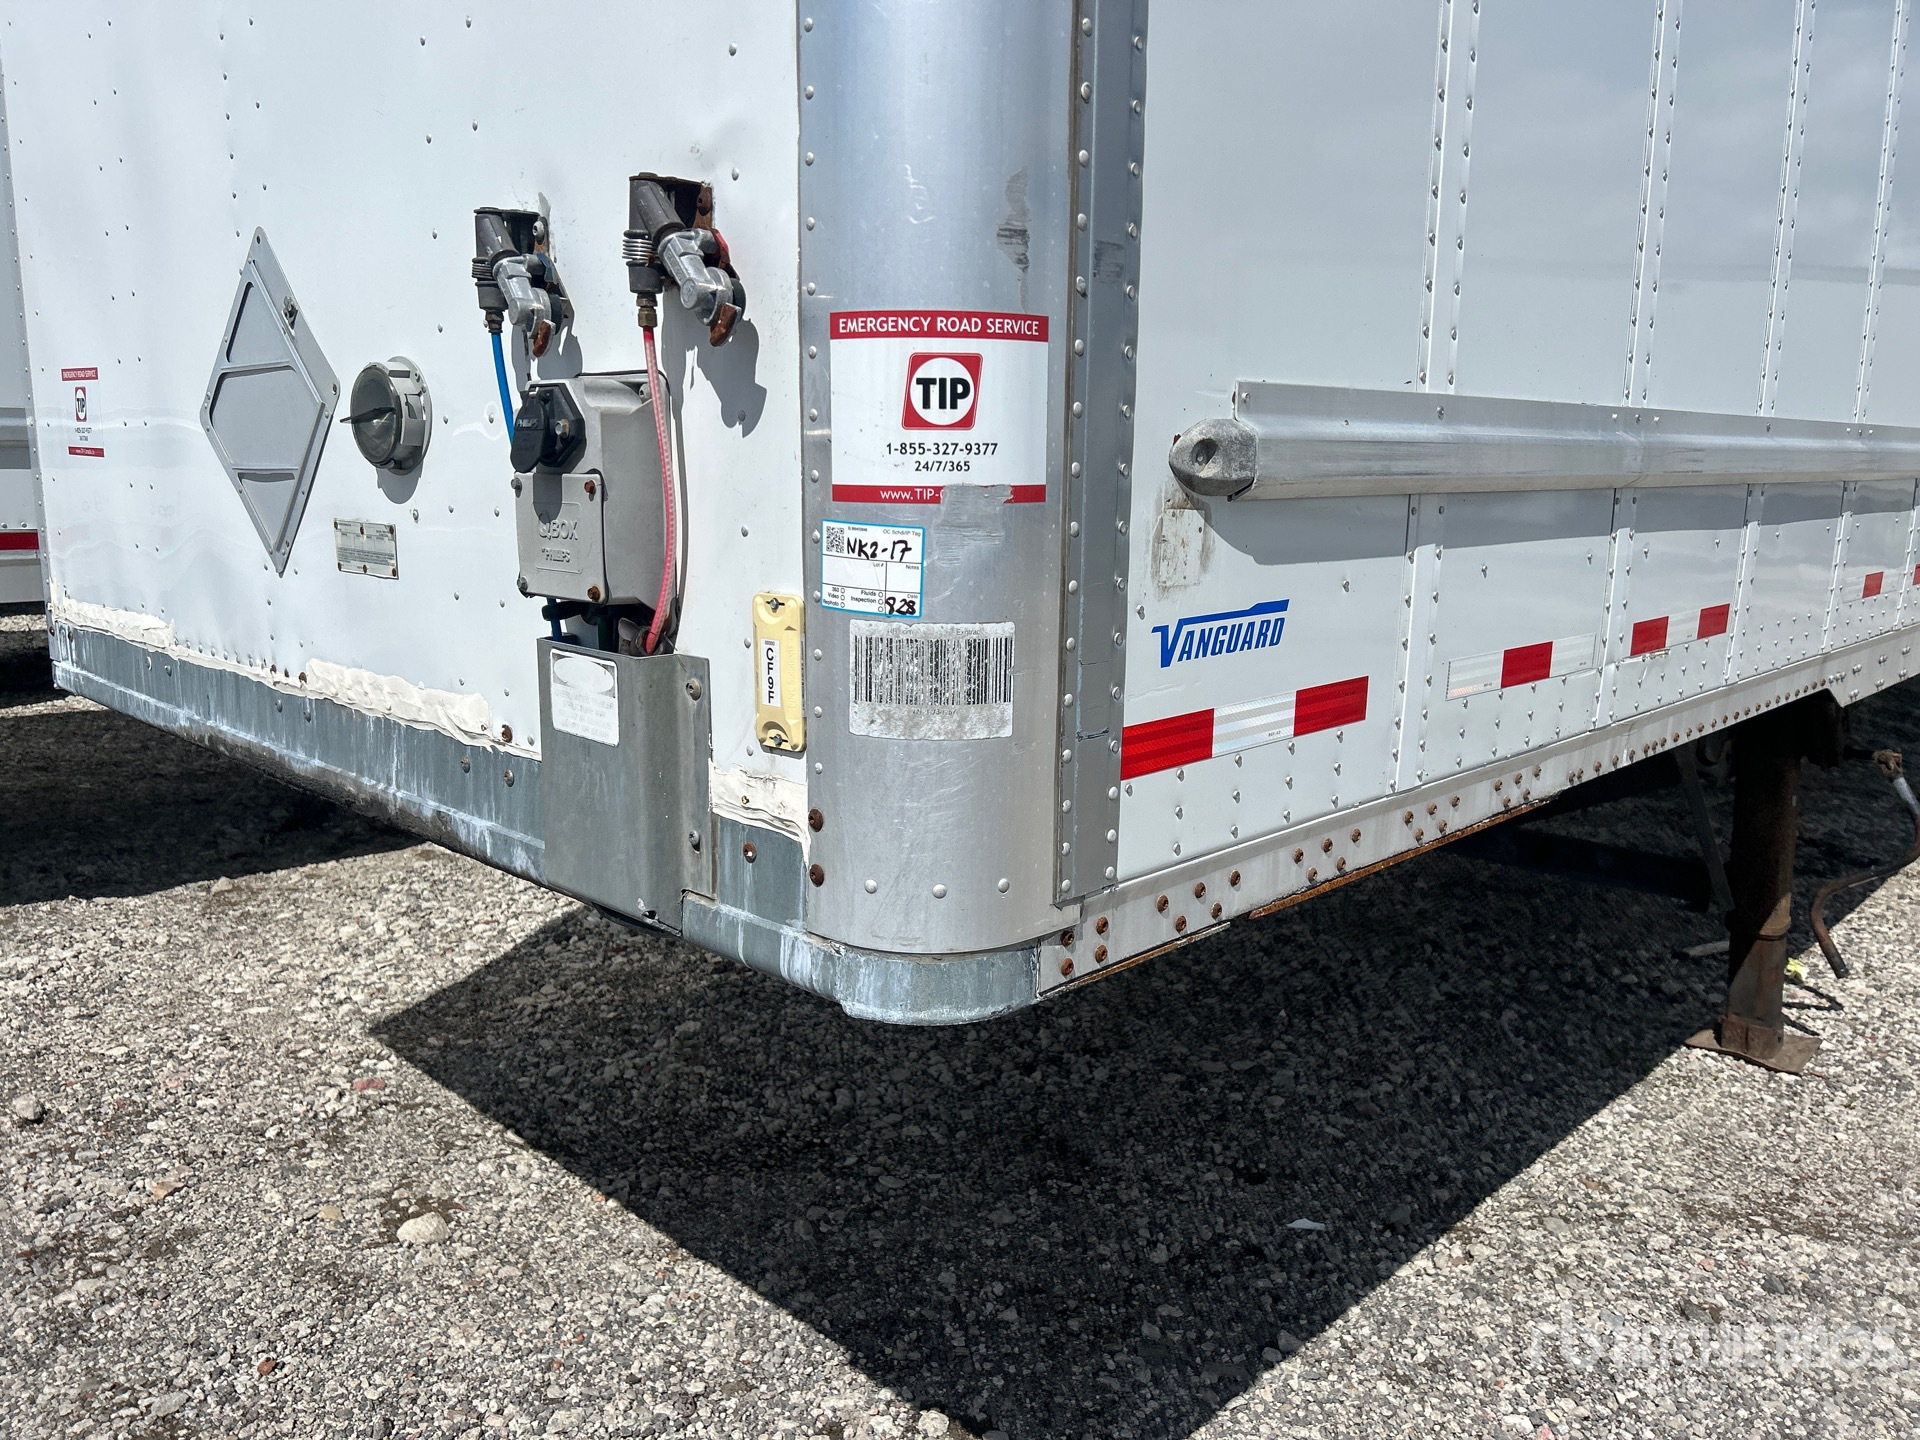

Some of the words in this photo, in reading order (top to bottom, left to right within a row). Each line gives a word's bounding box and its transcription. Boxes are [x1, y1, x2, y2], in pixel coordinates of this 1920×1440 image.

[839, 317, 931, 333] EMERGENCY
[936, 317, 982, 332] ROAD
[986, 318, 1040, 336] SERVICE
[916, 377, 971, 410] TIP
[76, 397, 87, 413] TIP
[886, 442, 998, 456] 1-855-327-9377
[914, 460, 971, 472] 24/7/365
[851, 596, 876, 604] Inspection
[1151, 599, 1290, 669] VANGUARD
